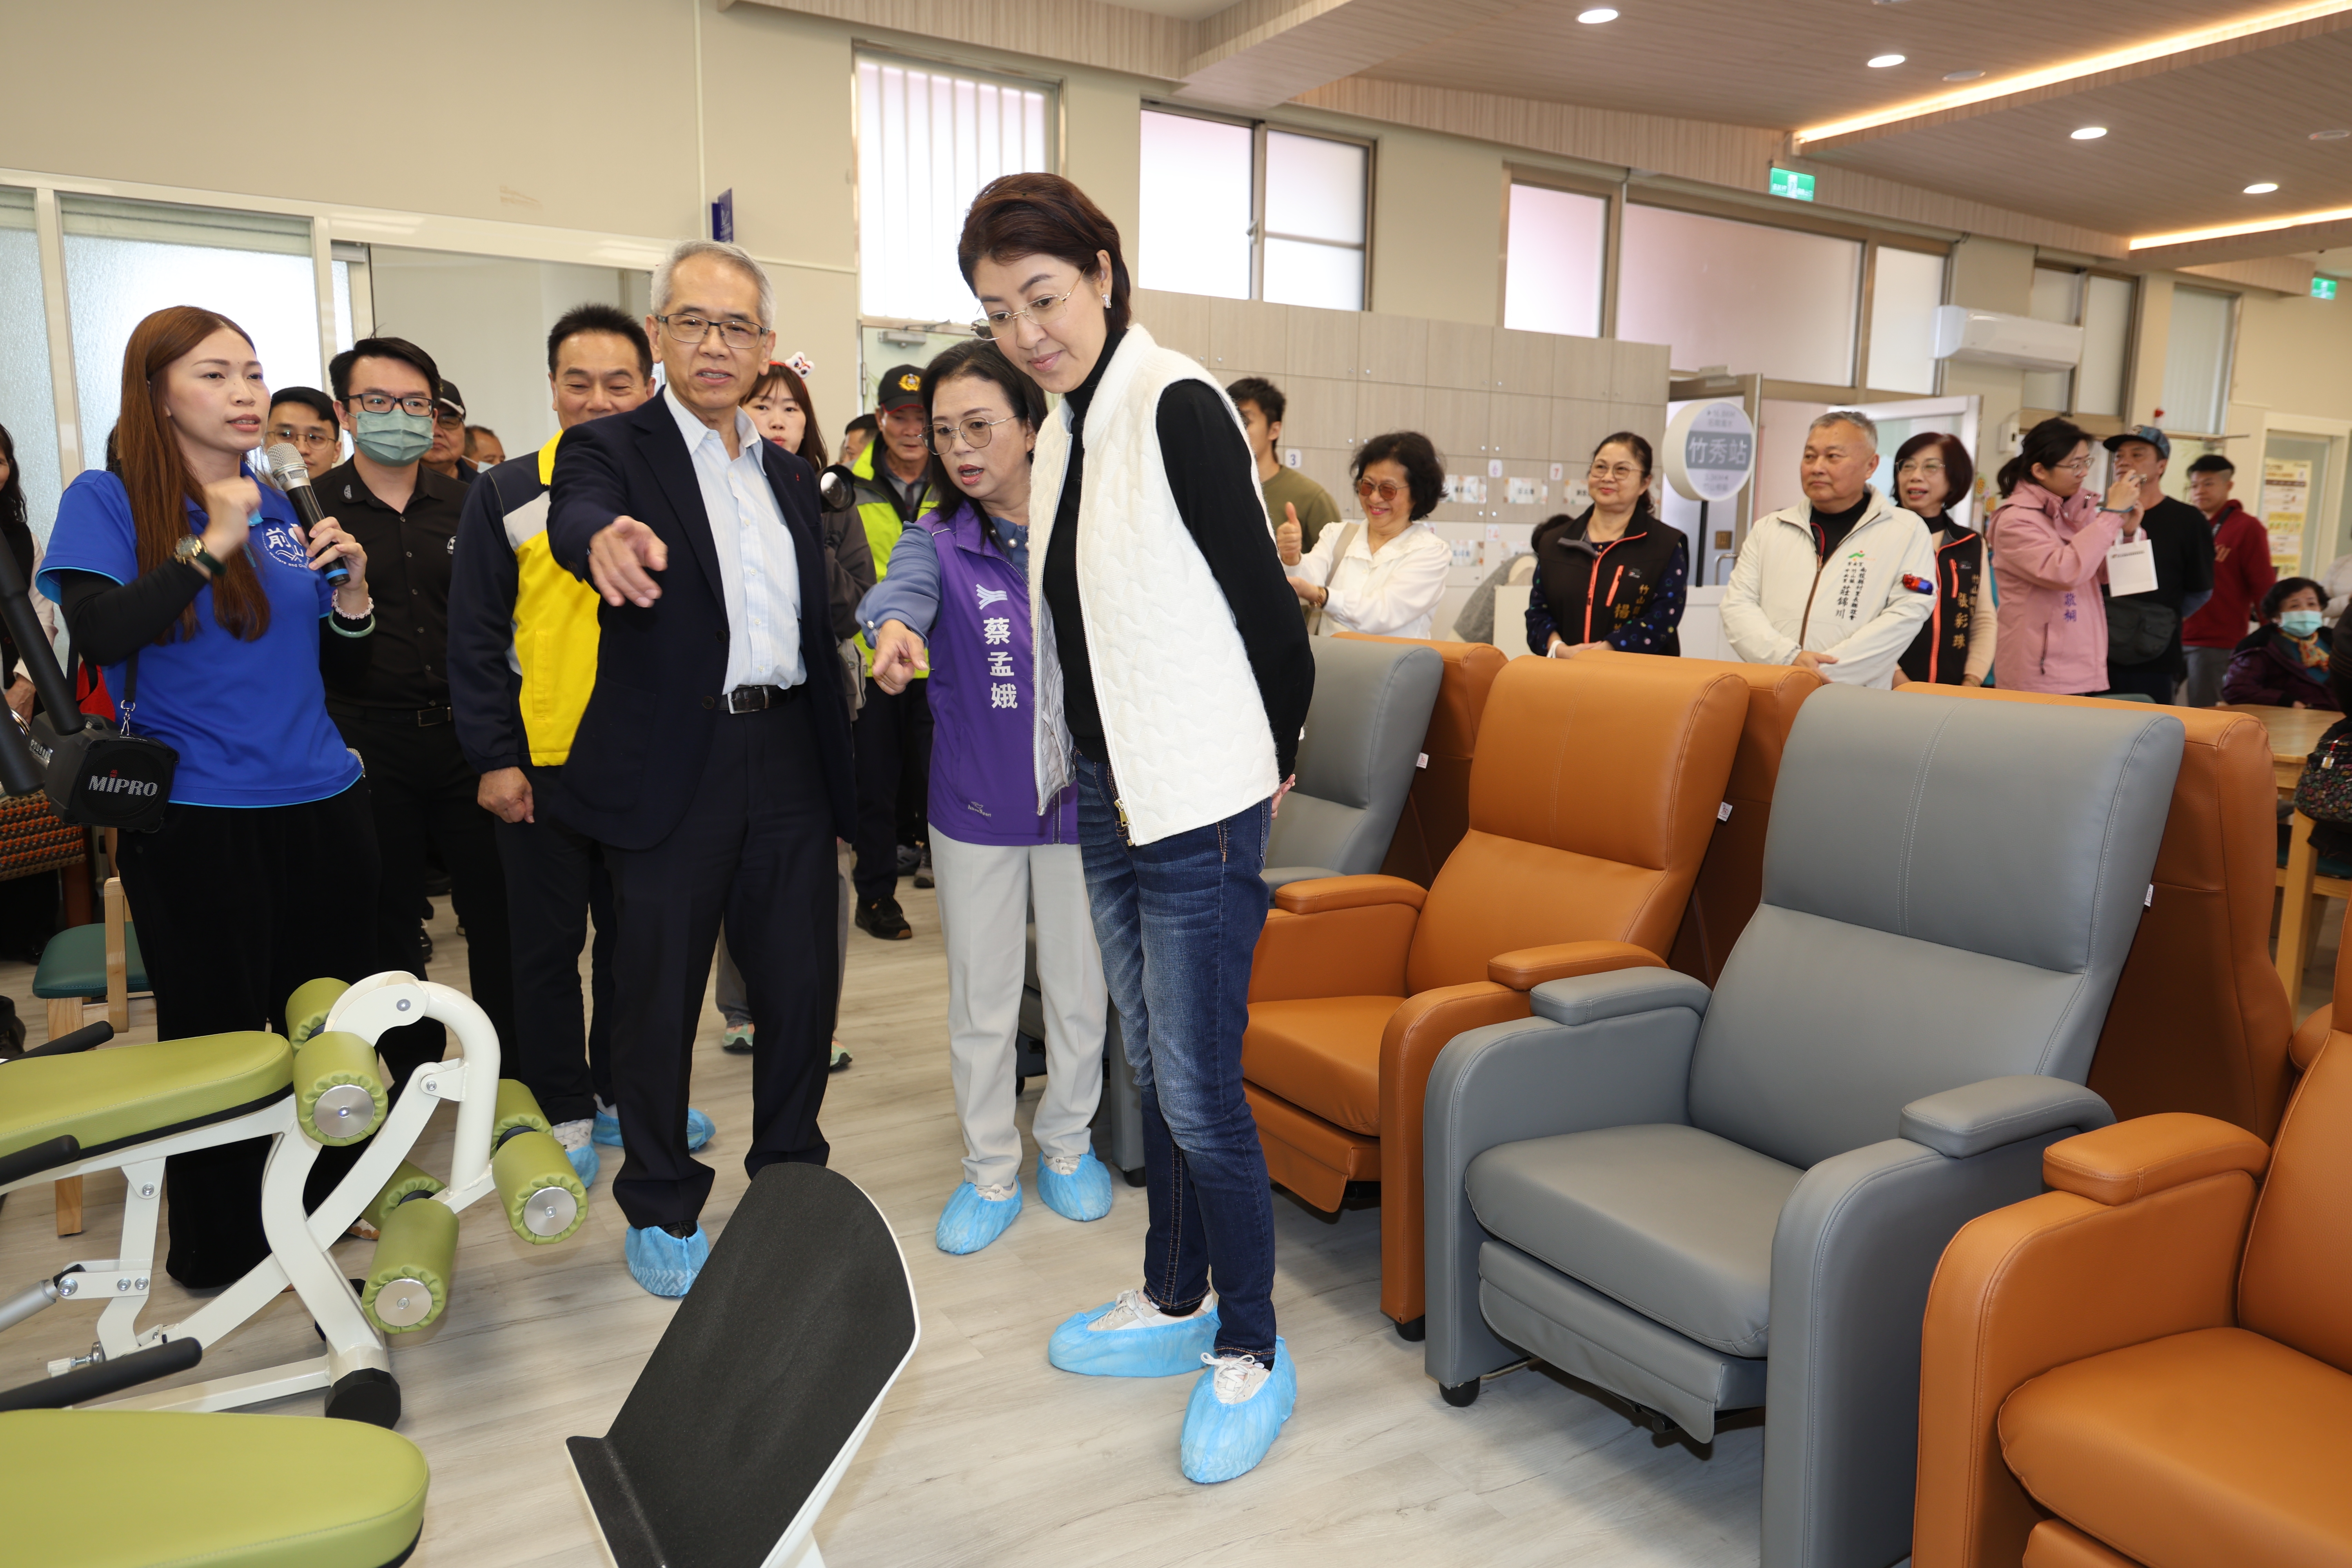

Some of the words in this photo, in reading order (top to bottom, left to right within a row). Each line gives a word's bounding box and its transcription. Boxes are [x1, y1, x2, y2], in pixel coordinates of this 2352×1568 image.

[1290, 454, 1296, 466] 3
[1688, 437, 1748, 465] 竹秀站
[1835, 584, 1851, 619] 莊錦川
[984, 617, 1018, 709] 蔡孟娥
